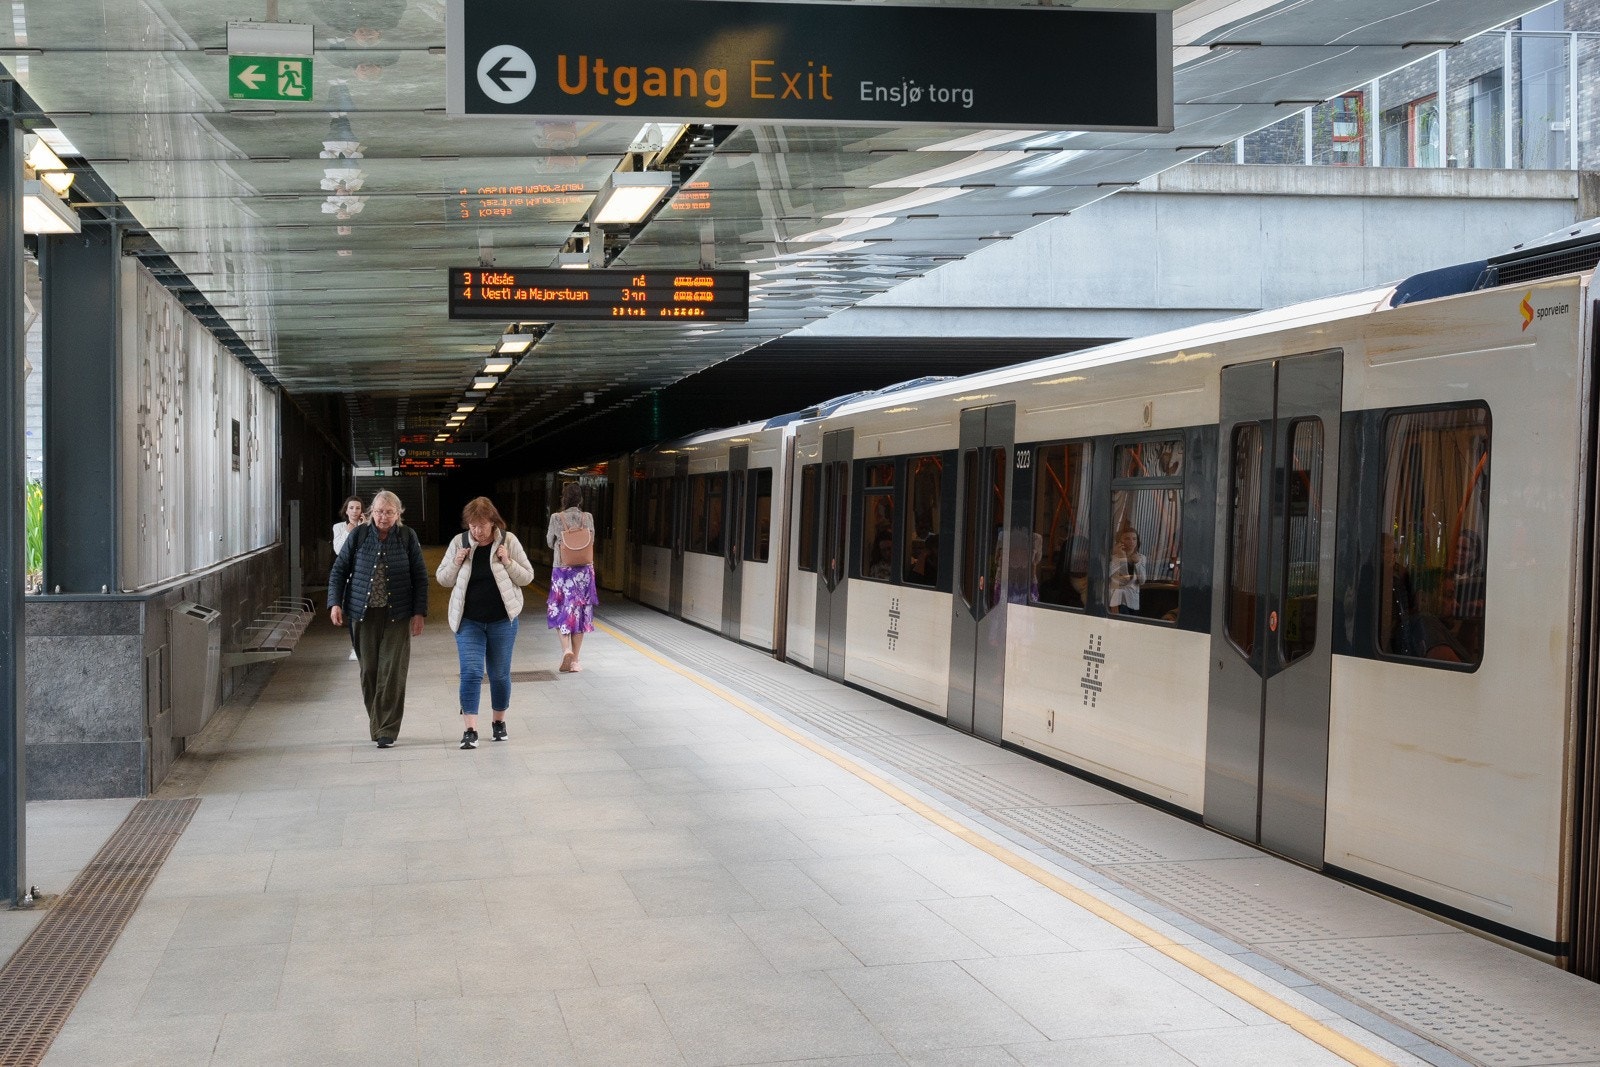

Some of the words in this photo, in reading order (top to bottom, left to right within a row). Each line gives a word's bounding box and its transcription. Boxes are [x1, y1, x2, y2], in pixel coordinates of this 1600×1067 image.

[558, 54, 728, 108] Utgang
[750, 59, 833, 100] Exit
[860, 79, 921, 107] Ensjø
[928, 84, 973, 108] torg
[463, 272, 473, 285] 3
[463, 287, 472, 300] 4
[1537, 302, 1569, 320] sporveien
[1016, 450, 1030, 469] 3223
